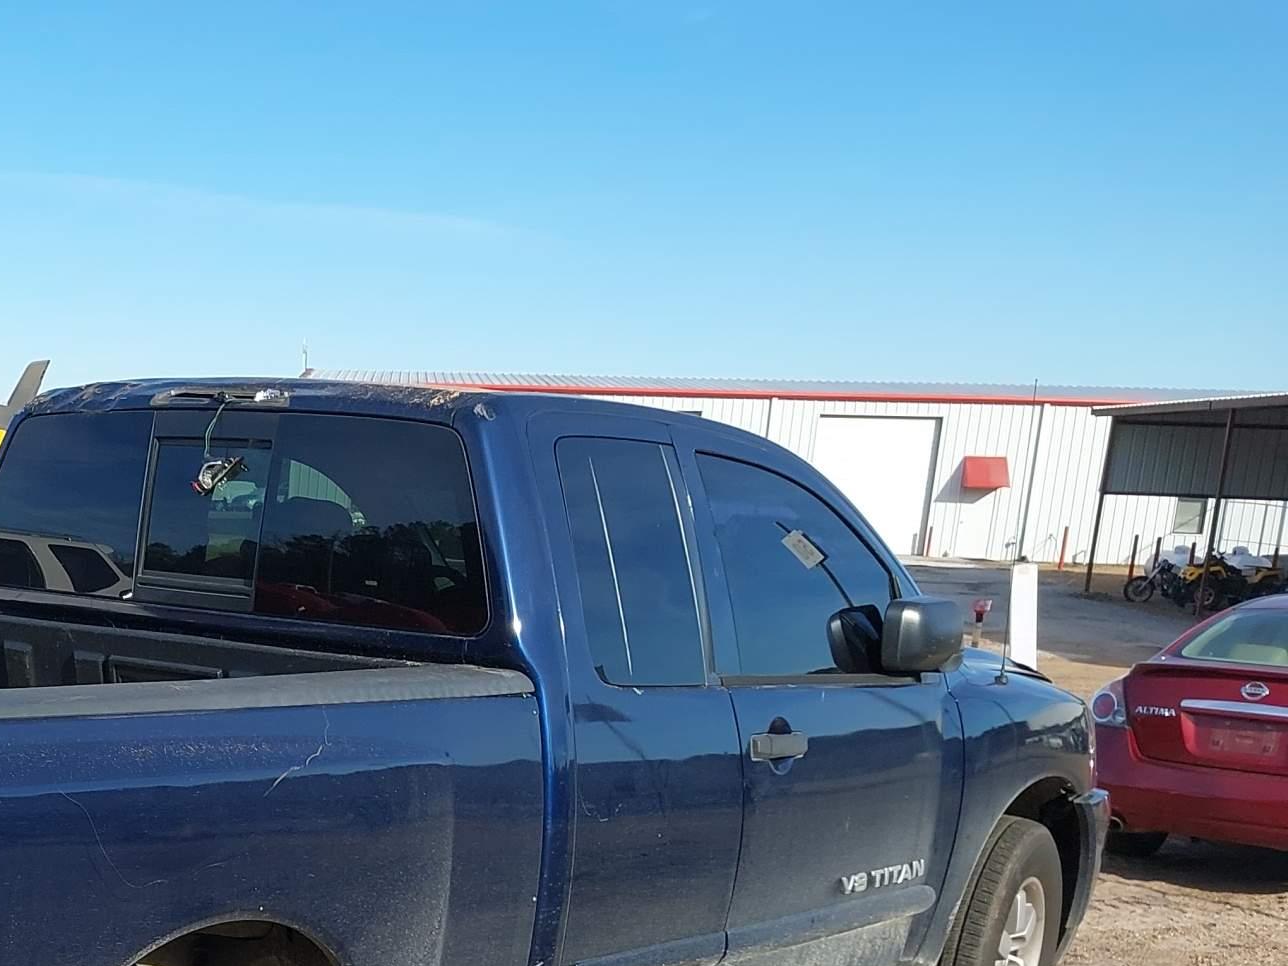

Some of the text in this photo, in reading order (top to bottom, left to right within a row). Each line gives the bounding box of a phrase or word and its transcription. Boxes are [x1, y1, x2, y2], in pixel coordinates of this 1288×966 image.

[1135, 706, 1177, 717] ALTIMA
[841, 858, 925, 895] V8 TITAN
